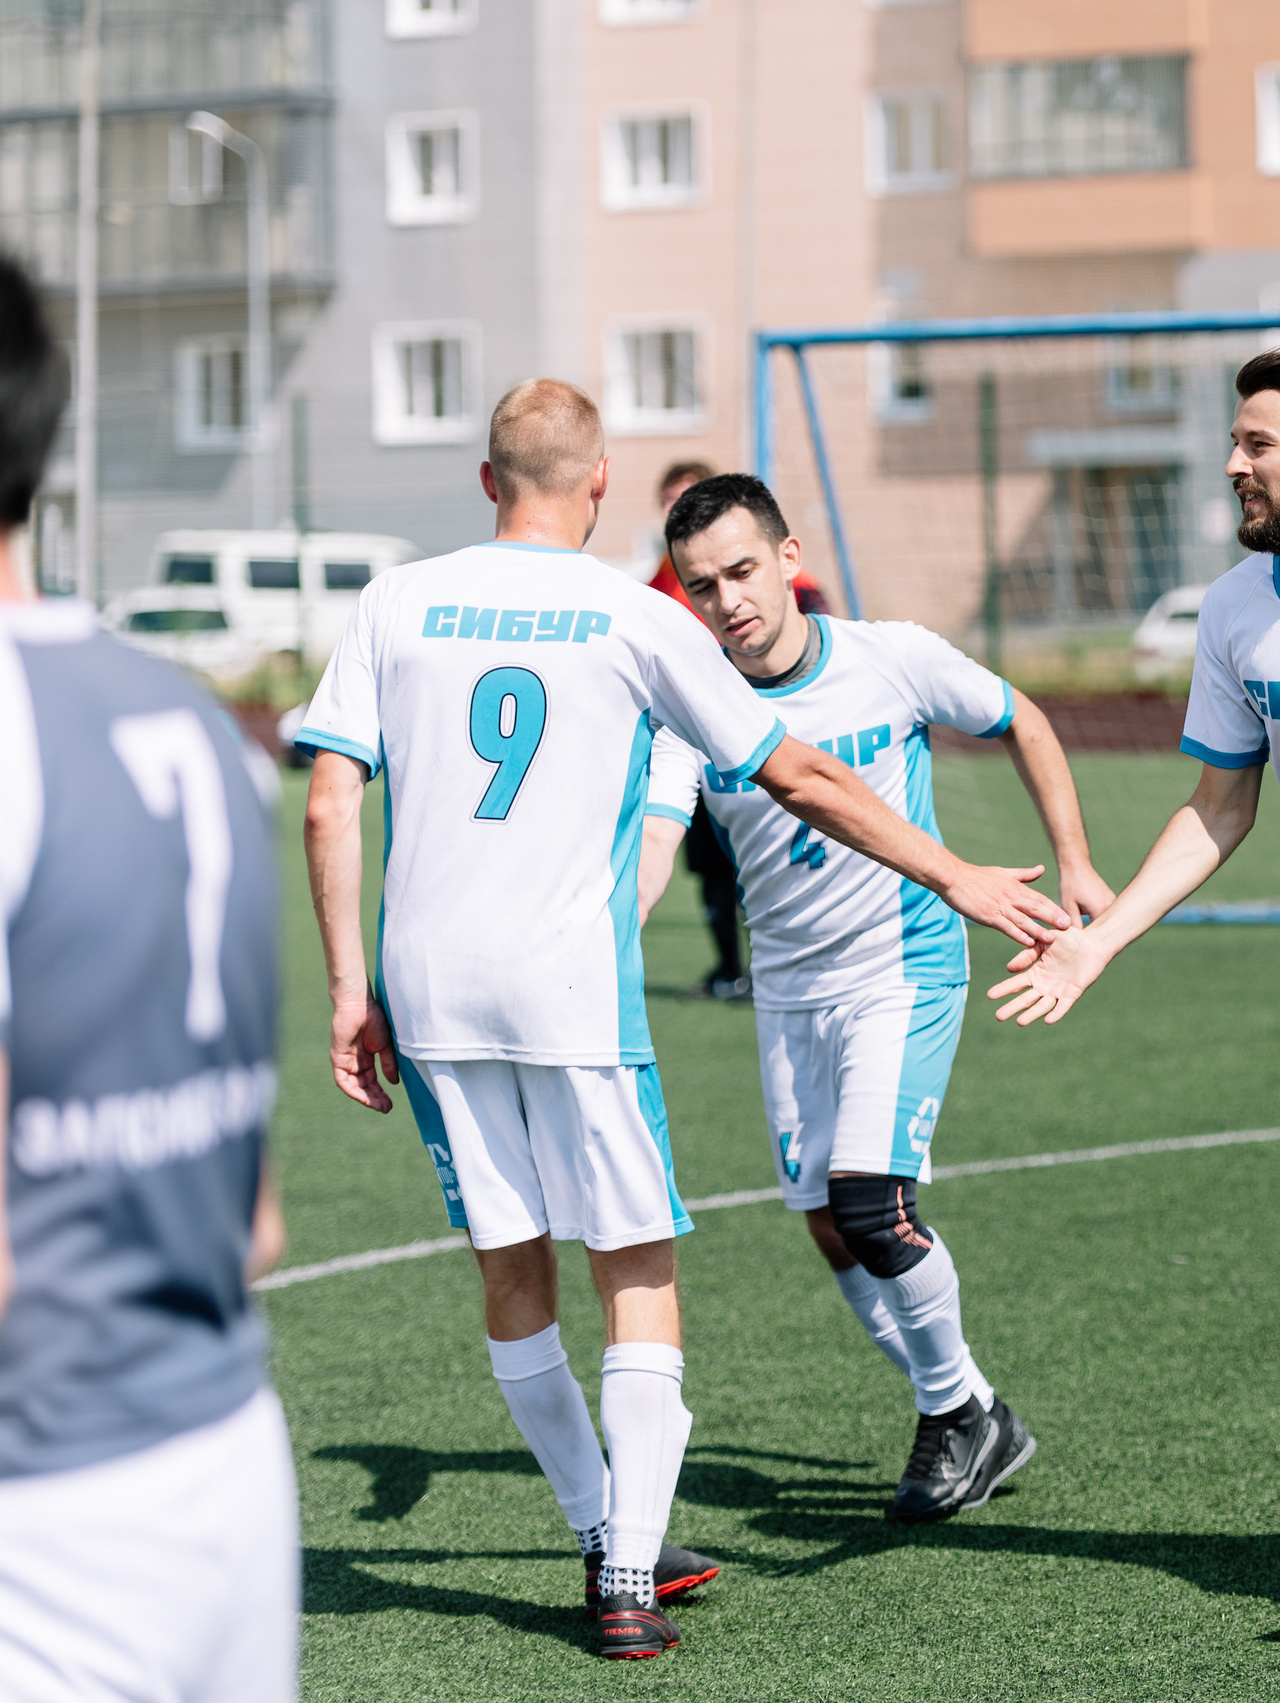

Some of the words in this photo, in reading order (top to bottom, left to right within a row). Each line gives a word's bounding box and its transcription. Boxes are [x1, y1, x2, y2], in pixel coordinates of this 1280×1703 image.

[421, 605, 612, 643] СИБУР
[467, 664, 549, 822] 9
[604, 1626, 643, 1636] TIEMPO
